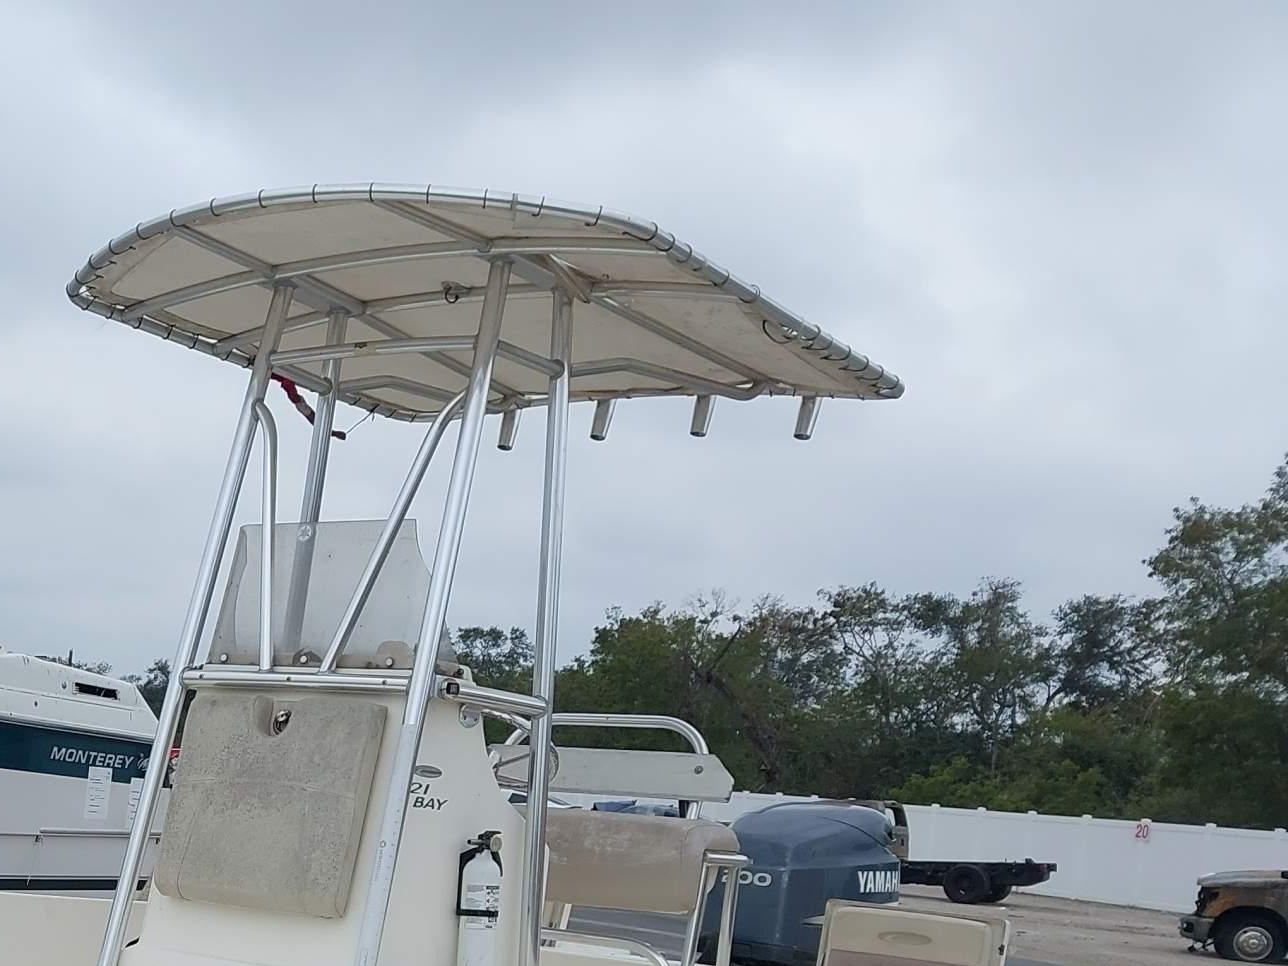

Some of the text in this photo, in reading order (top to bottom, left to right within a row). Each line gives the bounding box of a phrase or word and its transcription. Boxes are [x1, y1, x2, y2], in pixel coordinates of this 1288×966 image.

[50, 746, 134, 769] MONTEREY
[410, 782, 431, 795] 21
[413, 796, 448, 811] BAY
[1135, 824, 1149, 839] 20
